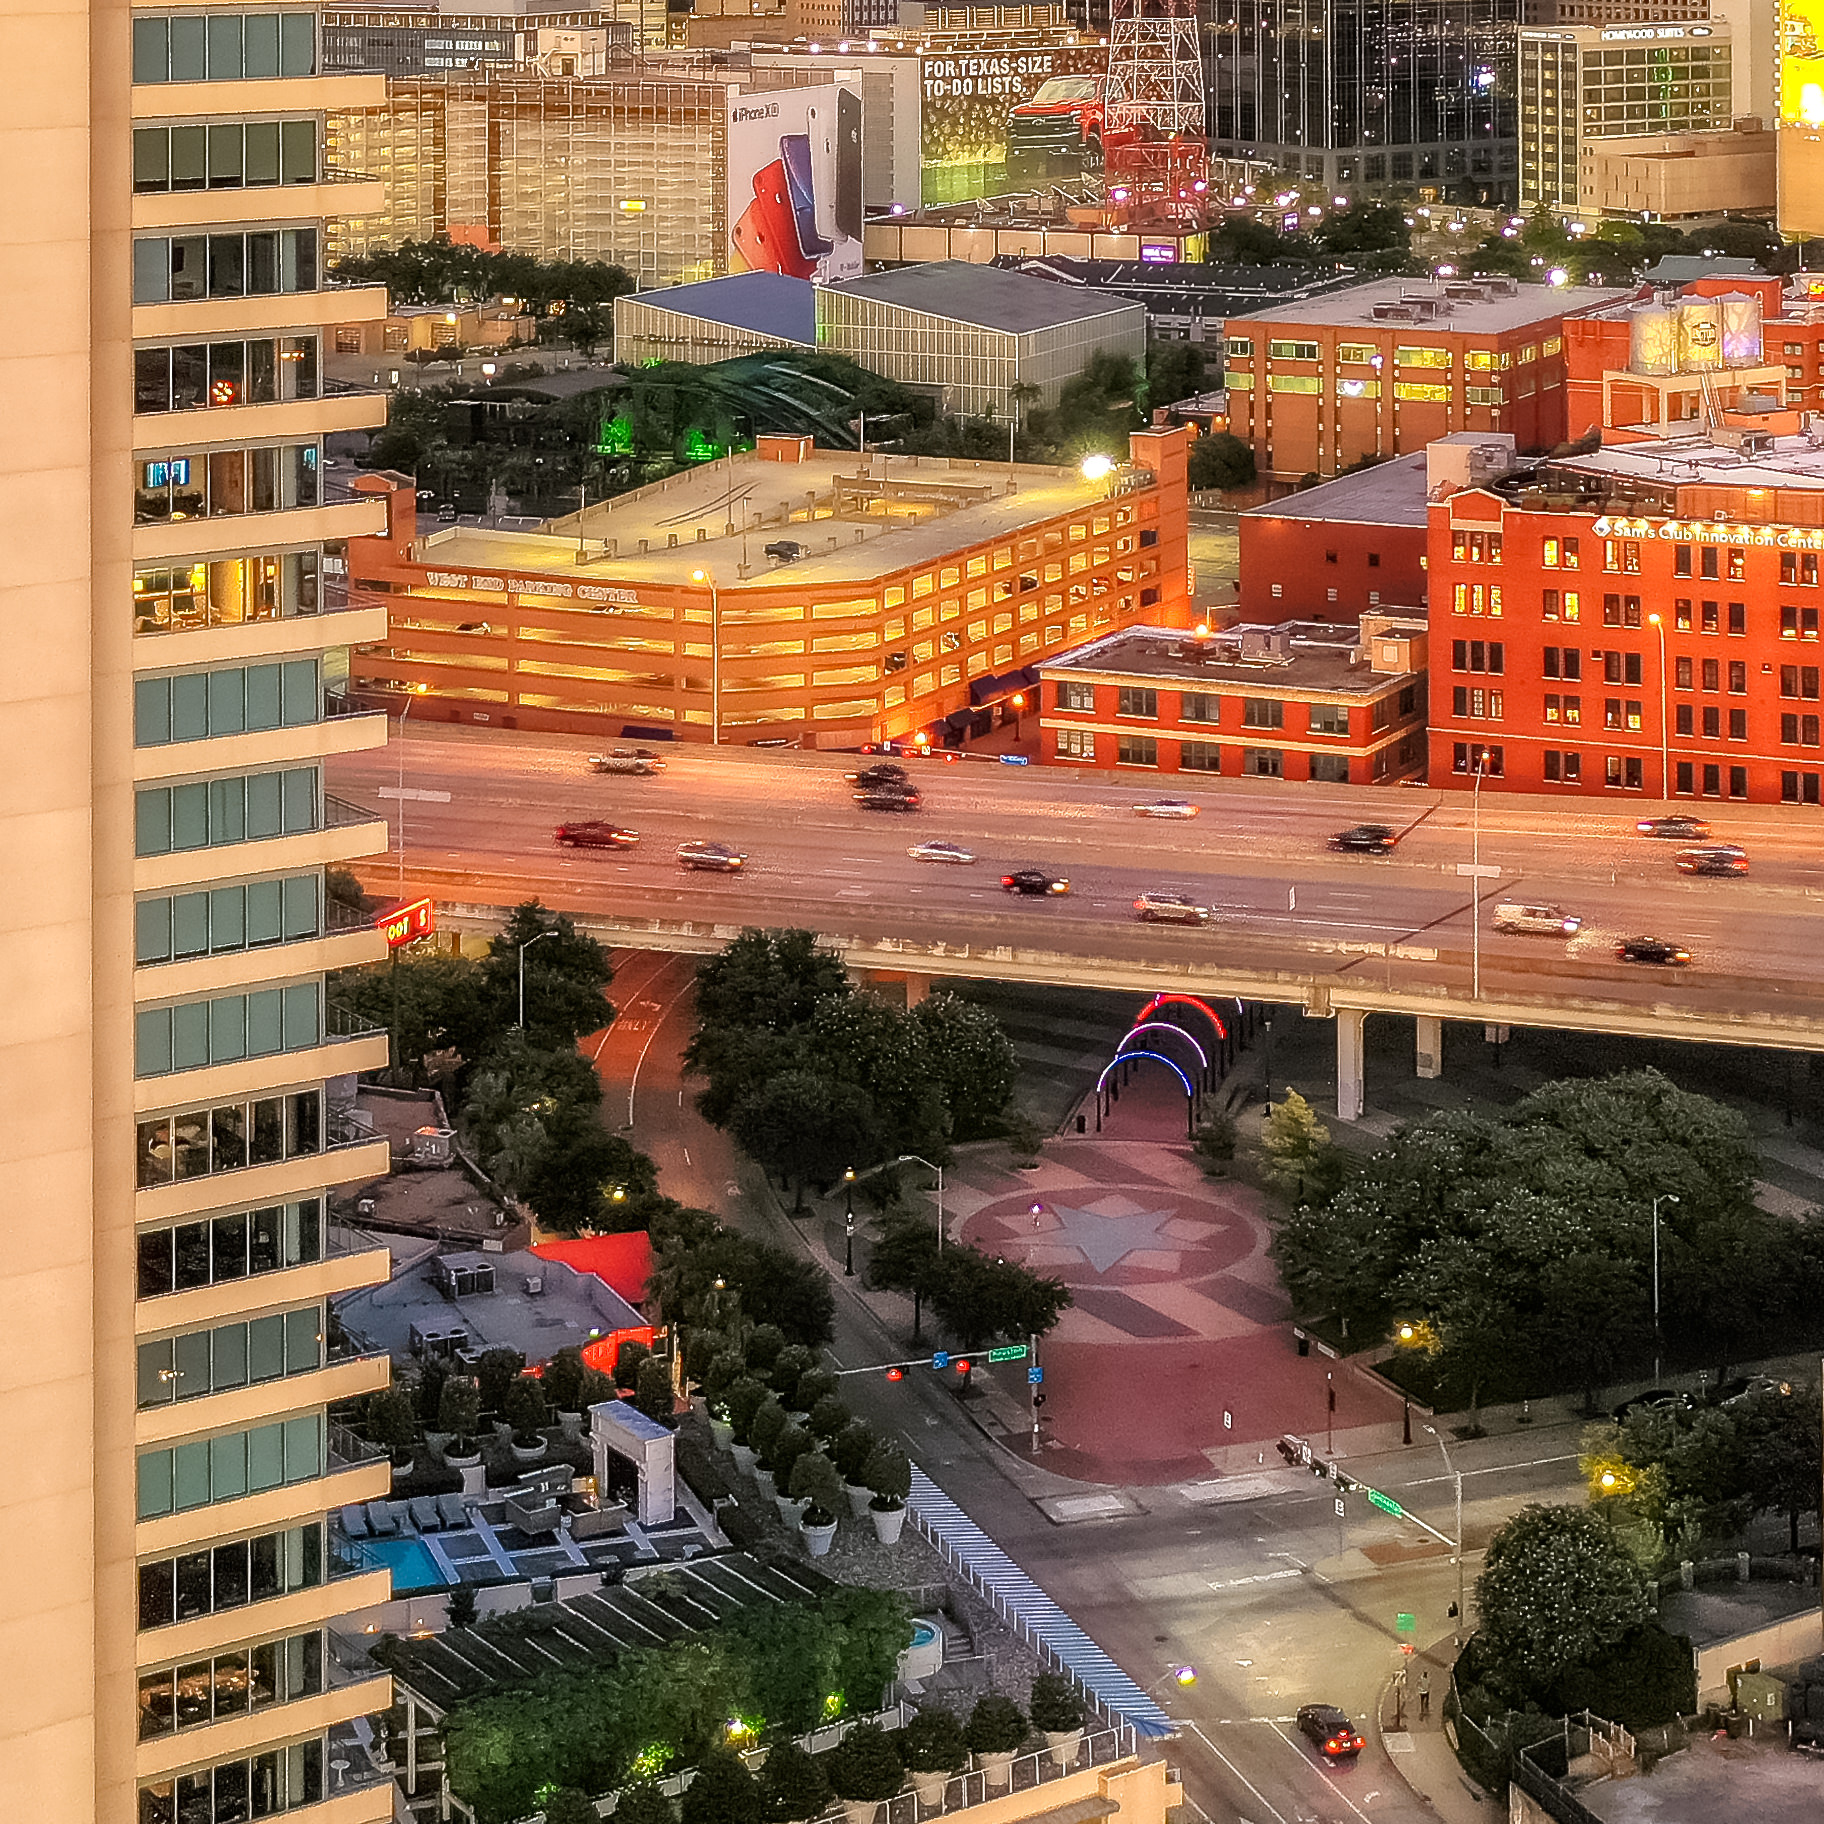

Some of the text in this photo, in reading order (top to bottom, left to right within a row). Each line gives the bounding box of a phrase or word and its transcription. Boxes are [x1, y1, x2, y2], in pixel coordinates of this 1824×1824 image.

[1601, 29, 1654, 40] HOMEWOOD
[1657, 28, 1684, 37] SUITES
[925, 56, 1052, 77] FOR TEXAS-SIZE
[924, 76, 1026, 96] TO-DO LISTS.
[1613, 525, 1656, 539] Sam's
[1659, 526, 1693, 540] Club
[1695, 528, 1773, 546] Innovation
[427, 572, 638, 603] WEST END PARKING CENTER
